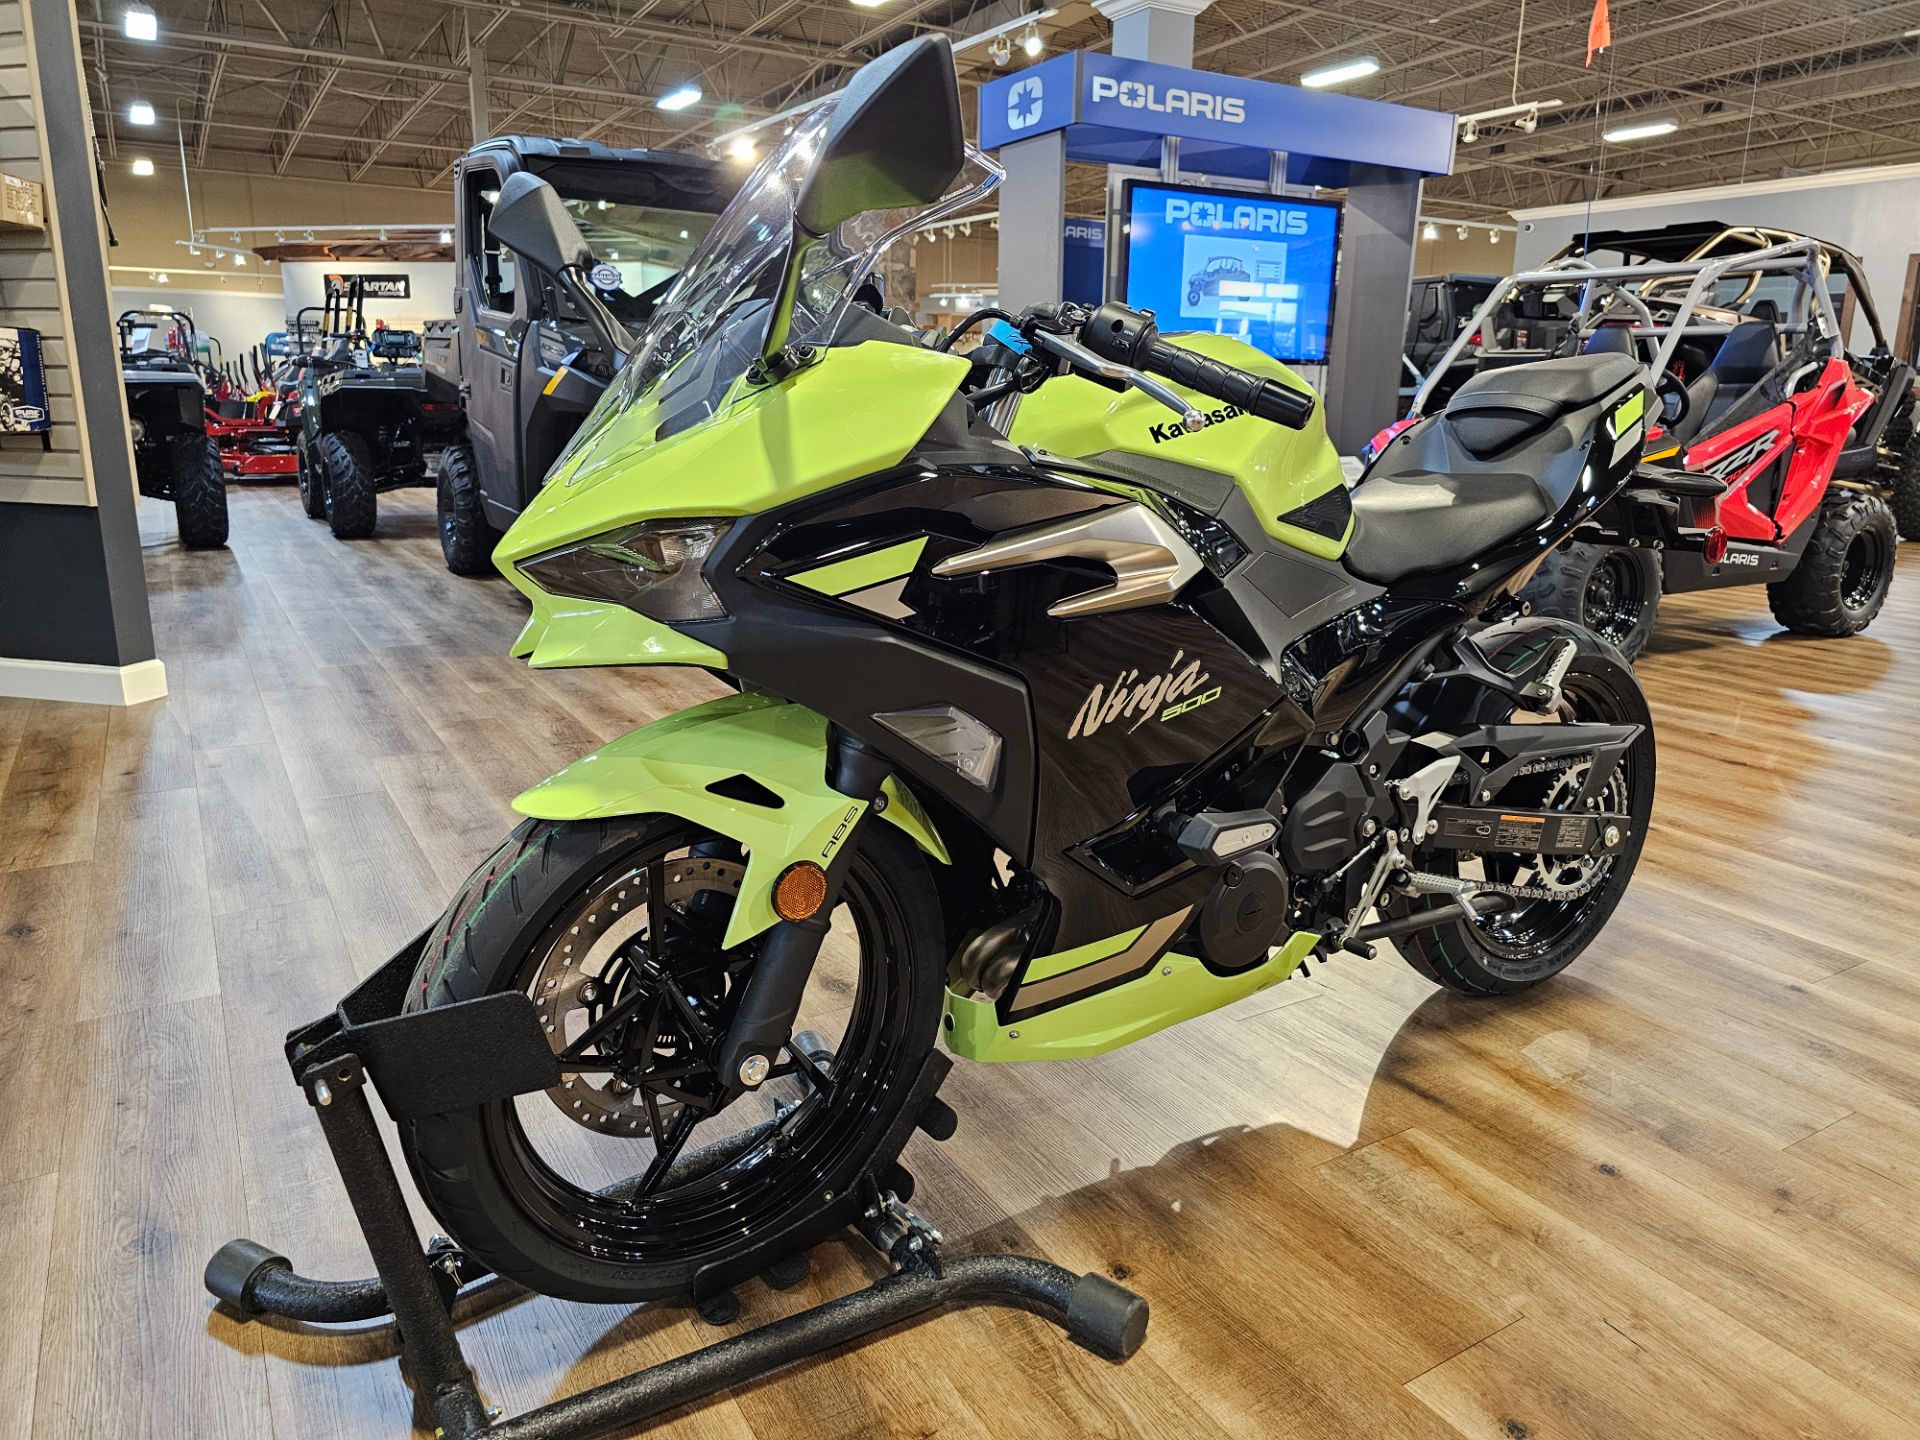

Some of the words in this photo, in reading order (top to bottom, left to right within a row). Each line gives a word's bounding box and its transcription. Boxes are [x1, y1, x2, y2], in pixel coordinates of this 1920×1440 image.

[1092, 75, 1246, 124] POLARIS
[1165, 198, 1309, 236] POLARIS
[343, 280, 405, 292] SARTAN
[1722, 552, 1760, 566] LARIS
[1066, 648, 1210, 740] Ninja
[1160, 685, 1222, 722] 500
[821, 805, 859, 858] ABS
